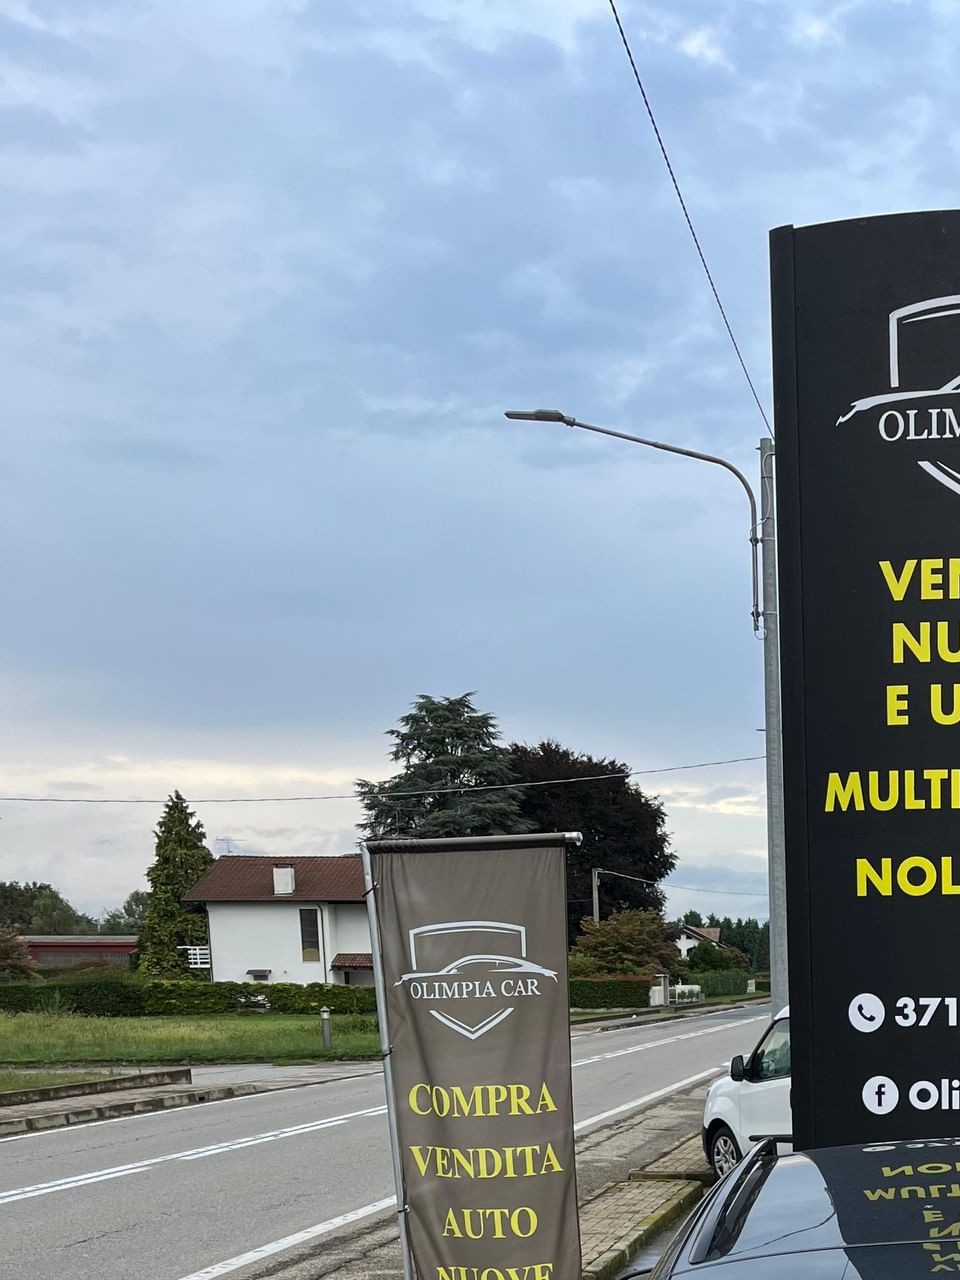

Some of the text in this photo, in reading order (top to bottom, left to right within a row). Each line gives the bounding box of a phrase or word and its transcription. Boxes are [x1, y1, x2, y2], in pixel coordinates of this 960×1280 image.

[886, 685, 910, 726] E
[410, 978, 542, 999] OLIMPIA CAR
[894, 996, 958, 1027] 371
[408, 1081, 558, 1118] COMPRA
[409, 1142, 565, 1180] VENDITA
[442, 1207, 538, 1239] AUTO
